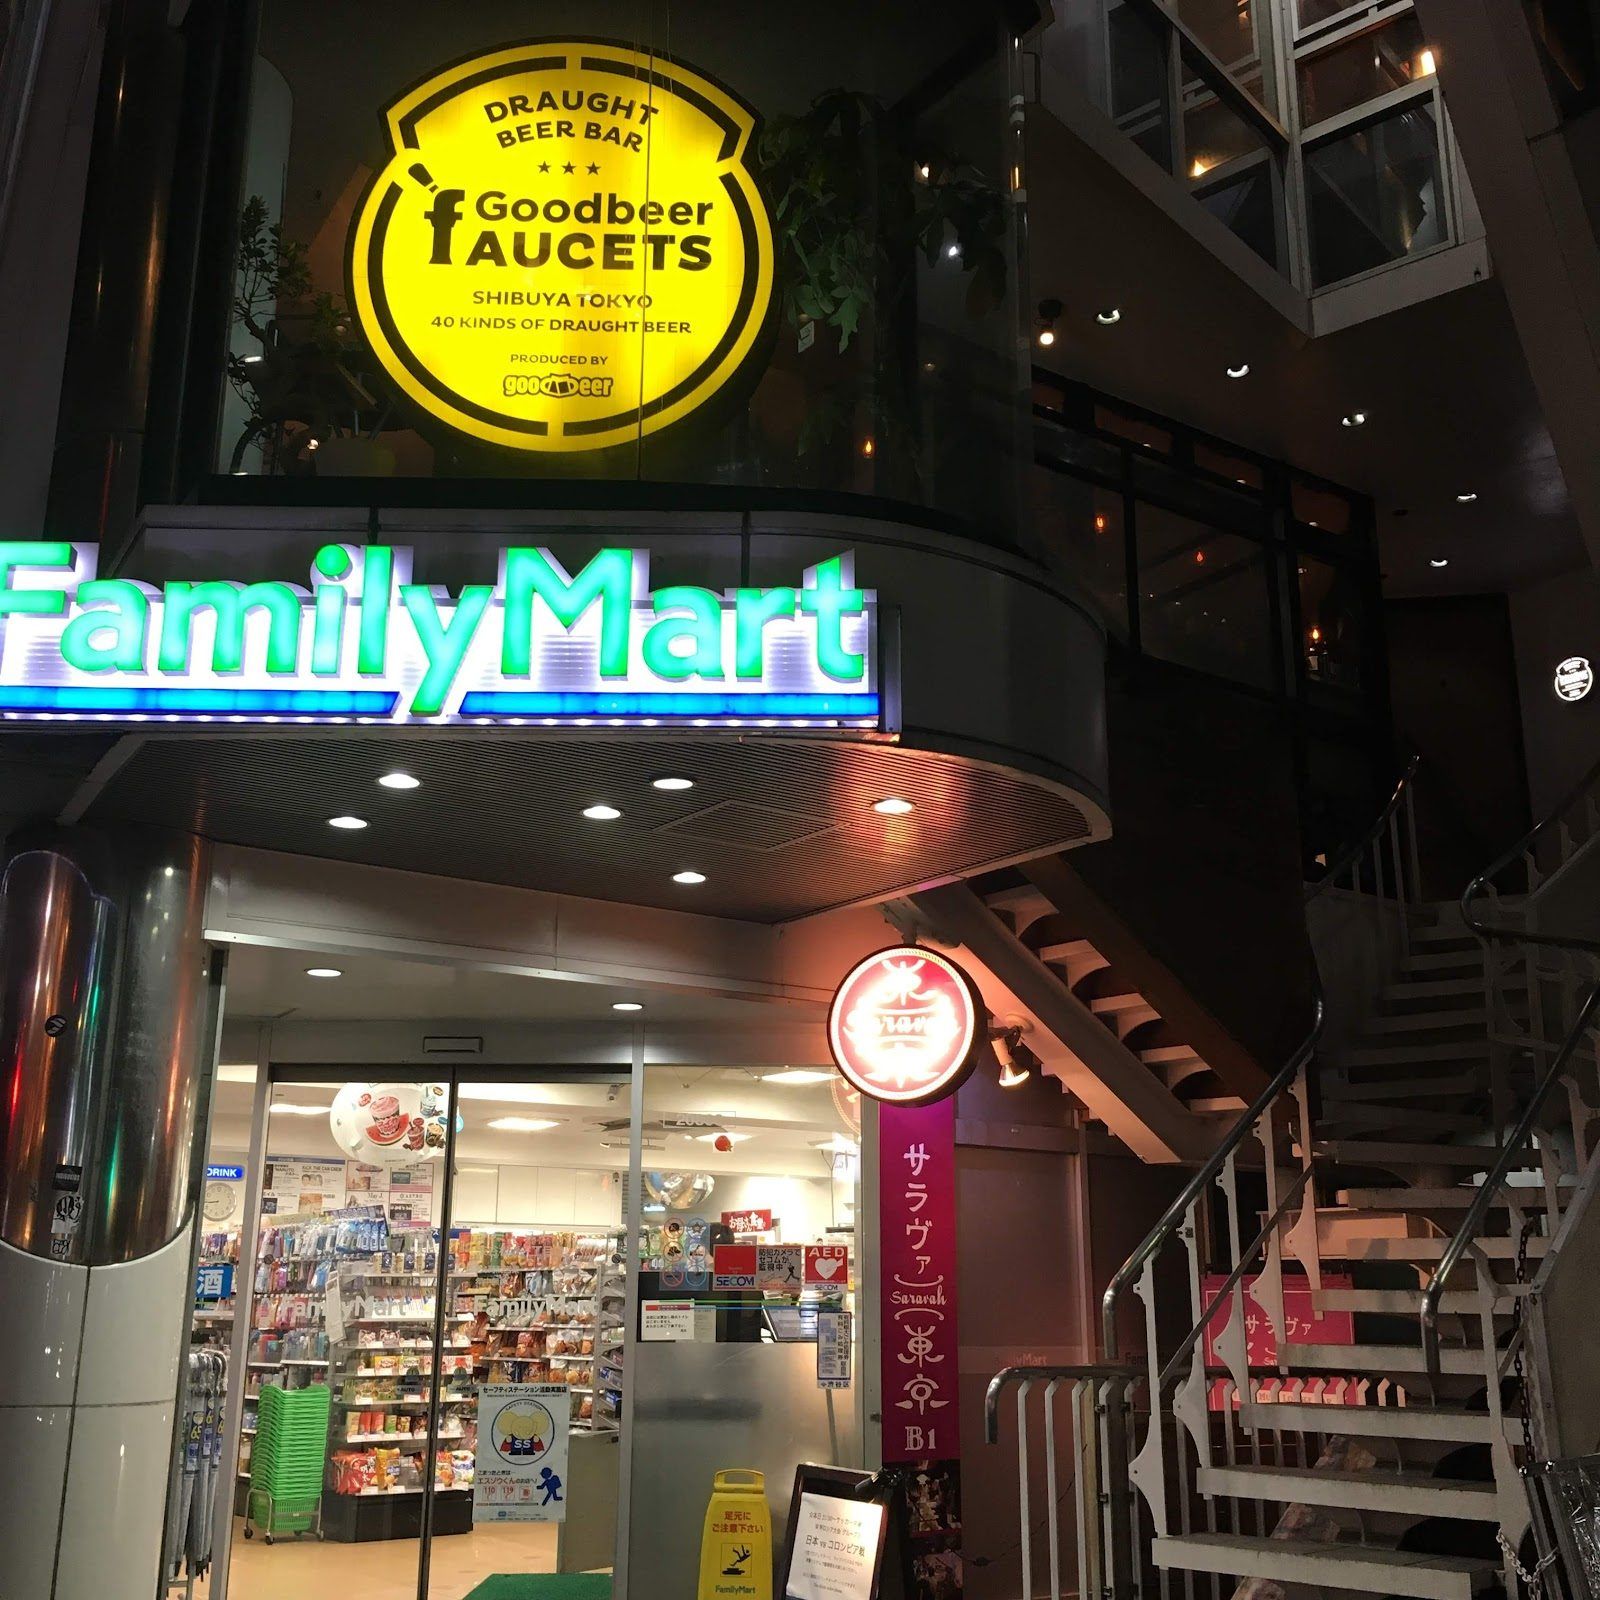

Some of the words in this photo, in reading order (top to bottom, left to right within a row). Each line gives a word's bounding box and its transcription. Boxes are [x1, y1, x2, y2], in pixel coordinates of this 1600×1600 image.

[484, 90, 659, 126] DRAUGHT
[496, 120, 575, 149] BEER
[584, 121, 643, 153] BAR
[475, 191, 713, 226] Goodbeer
[473, 290, 571, 308] SHIBUYA
[576, 293, 653, 309] TOKYO
[431, 316, 455, 329] 40
[459, 317, 516, 330] KINDS
[521, 318, 545, 330] OF
[549, 319, 640, 333] DRAUGHT
[643, 321, 692, 334] BEER
[510, 353, 588, 365] PRODUCED
[590, 356, 608, 366] BY
[0, 540, 868, 716] FamilyMart
[903, 1142, 933, 1275] サラヴァ
[809, 1247, 845, 1258] AED
[197, 1269, 224, 1296] 酒
[716, 1276, 755, 1287] SECOM
[890, 1284, 948, 1306] Saravah
[894, 1324, 950, 1417] 東京
[514, 1439, 531, 1449] SS
[904, 1425, 938, 1451] B1
[724, 1511, 751, 1521] 足元に
[712, 1523, 763, 1533] ご注意下さい
[805, 1534, 819, 1547] 日本
[715, 1584, 756, 1595] FamilyMart
